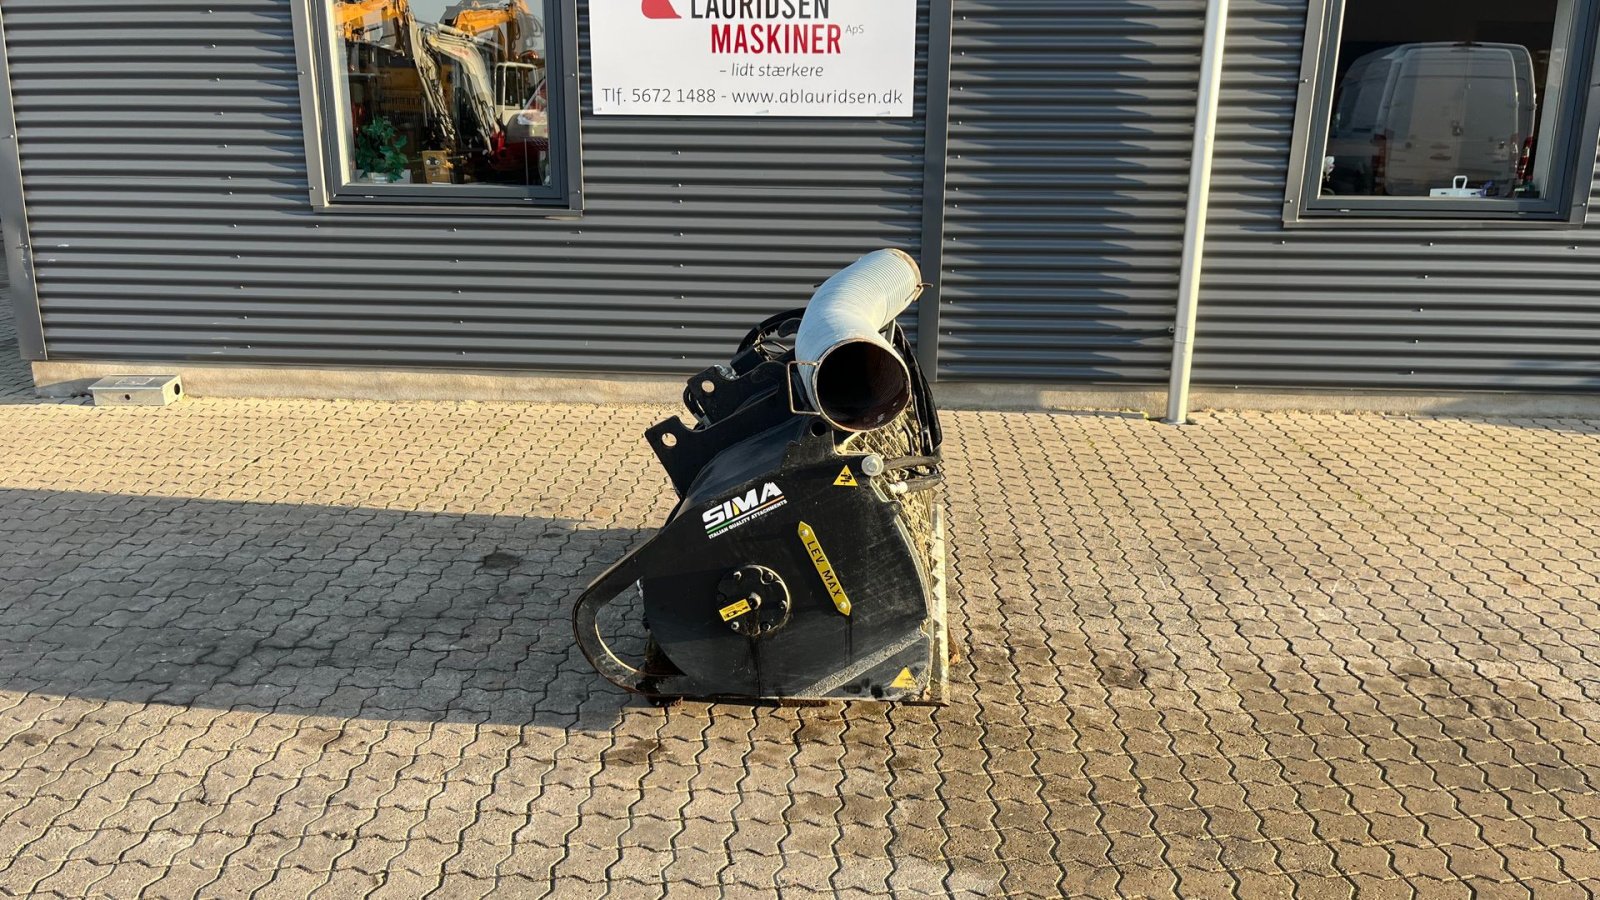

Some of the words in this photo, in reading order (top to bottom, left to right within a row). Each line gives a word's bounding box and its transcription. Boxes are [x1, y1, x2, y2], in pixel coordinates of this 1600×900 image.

[691, 0, 829, 19] LAURIDSEN
[711, 24, 842, 54] MASKINER
[845, 24, 865, 36] ApS
[731, 63, 755, 77] lidt
[758, 63, 824, 77] stærkere
[602, 87, 627, 106] Tlf.
[632, 88, 671, 103] 5672
[676, 88, 716, 103] 1488
[732, 89, 903, 104] www.ablauridsen.dk
[702, 481, 783, 530] SIMA
[708, 527, 729, 540] ITALIAN
[728, 516, 751, 530] QUALITY
[751, 499, 788, 520] ATTACHMENTS
[822, 569, 842, 598] MAX
